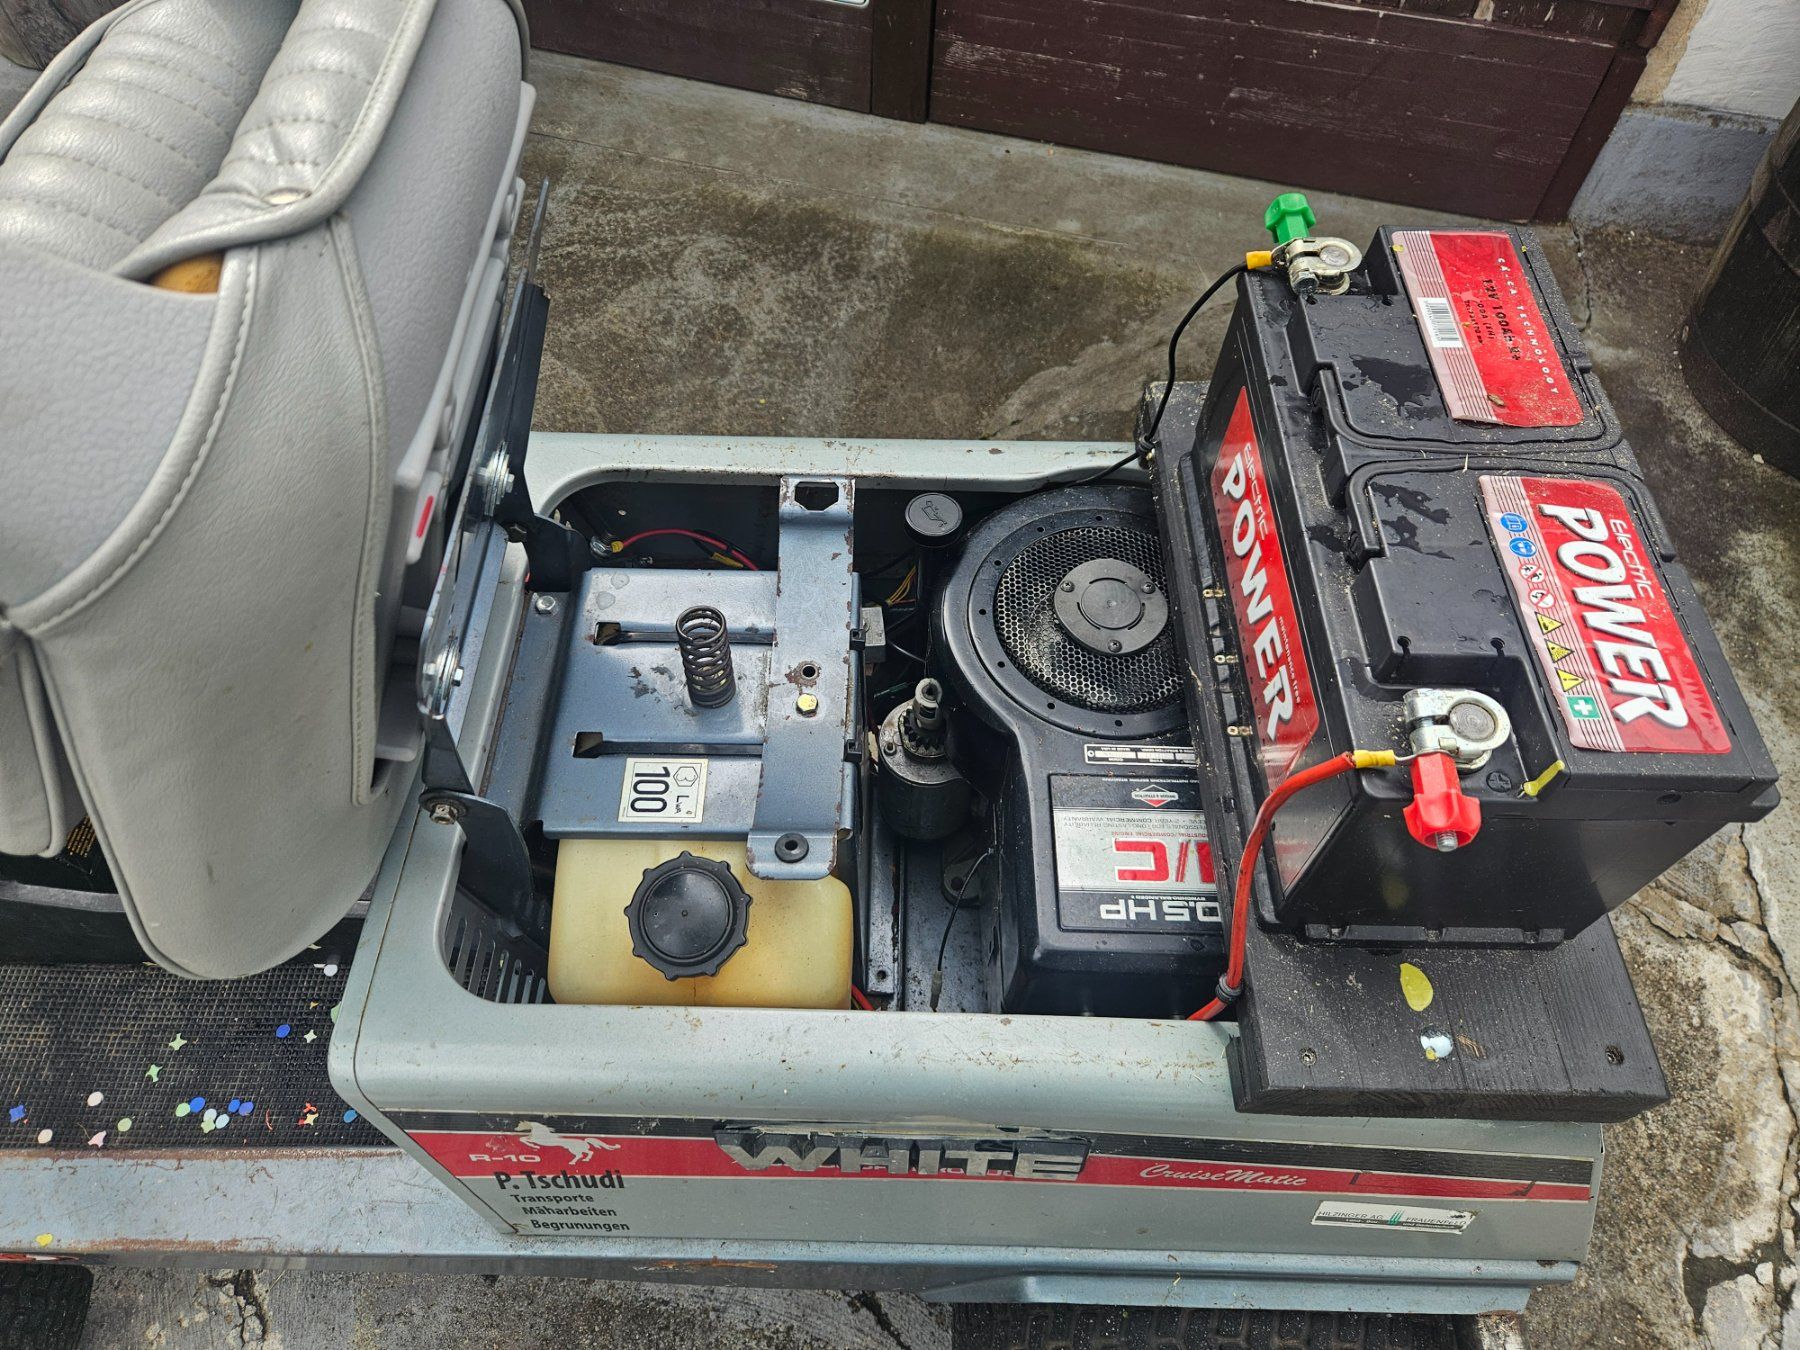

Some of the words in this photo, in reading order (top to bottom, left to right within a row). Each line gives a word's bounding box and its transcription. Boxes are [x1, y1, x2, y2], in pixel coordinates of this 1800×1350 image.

[1517, 305, 1559, 394] TECHNOLOGY
[1221, 452, 1295, 742] POWER
[1537, 502, 1690, 729] POWER
[1278, 615, 1297, 677] maintenance
[1291, 676, 1302, 704] free
[630, 766, 670, 813] 100
[468, 1153, 541, 1162] R-10
[715, 1132, 1090, 1182] WHITE
[1139, 1163, 1308, 1186] CruiseMatic
[510, 1193, 594, 1204] Transporte
[523, 1206, 617, 1217] Mäharbeiten
[1318, 1211, 1367, 1219] HILZINGER
[1405, 1217, 1467, 1226] FRAUENFELD
